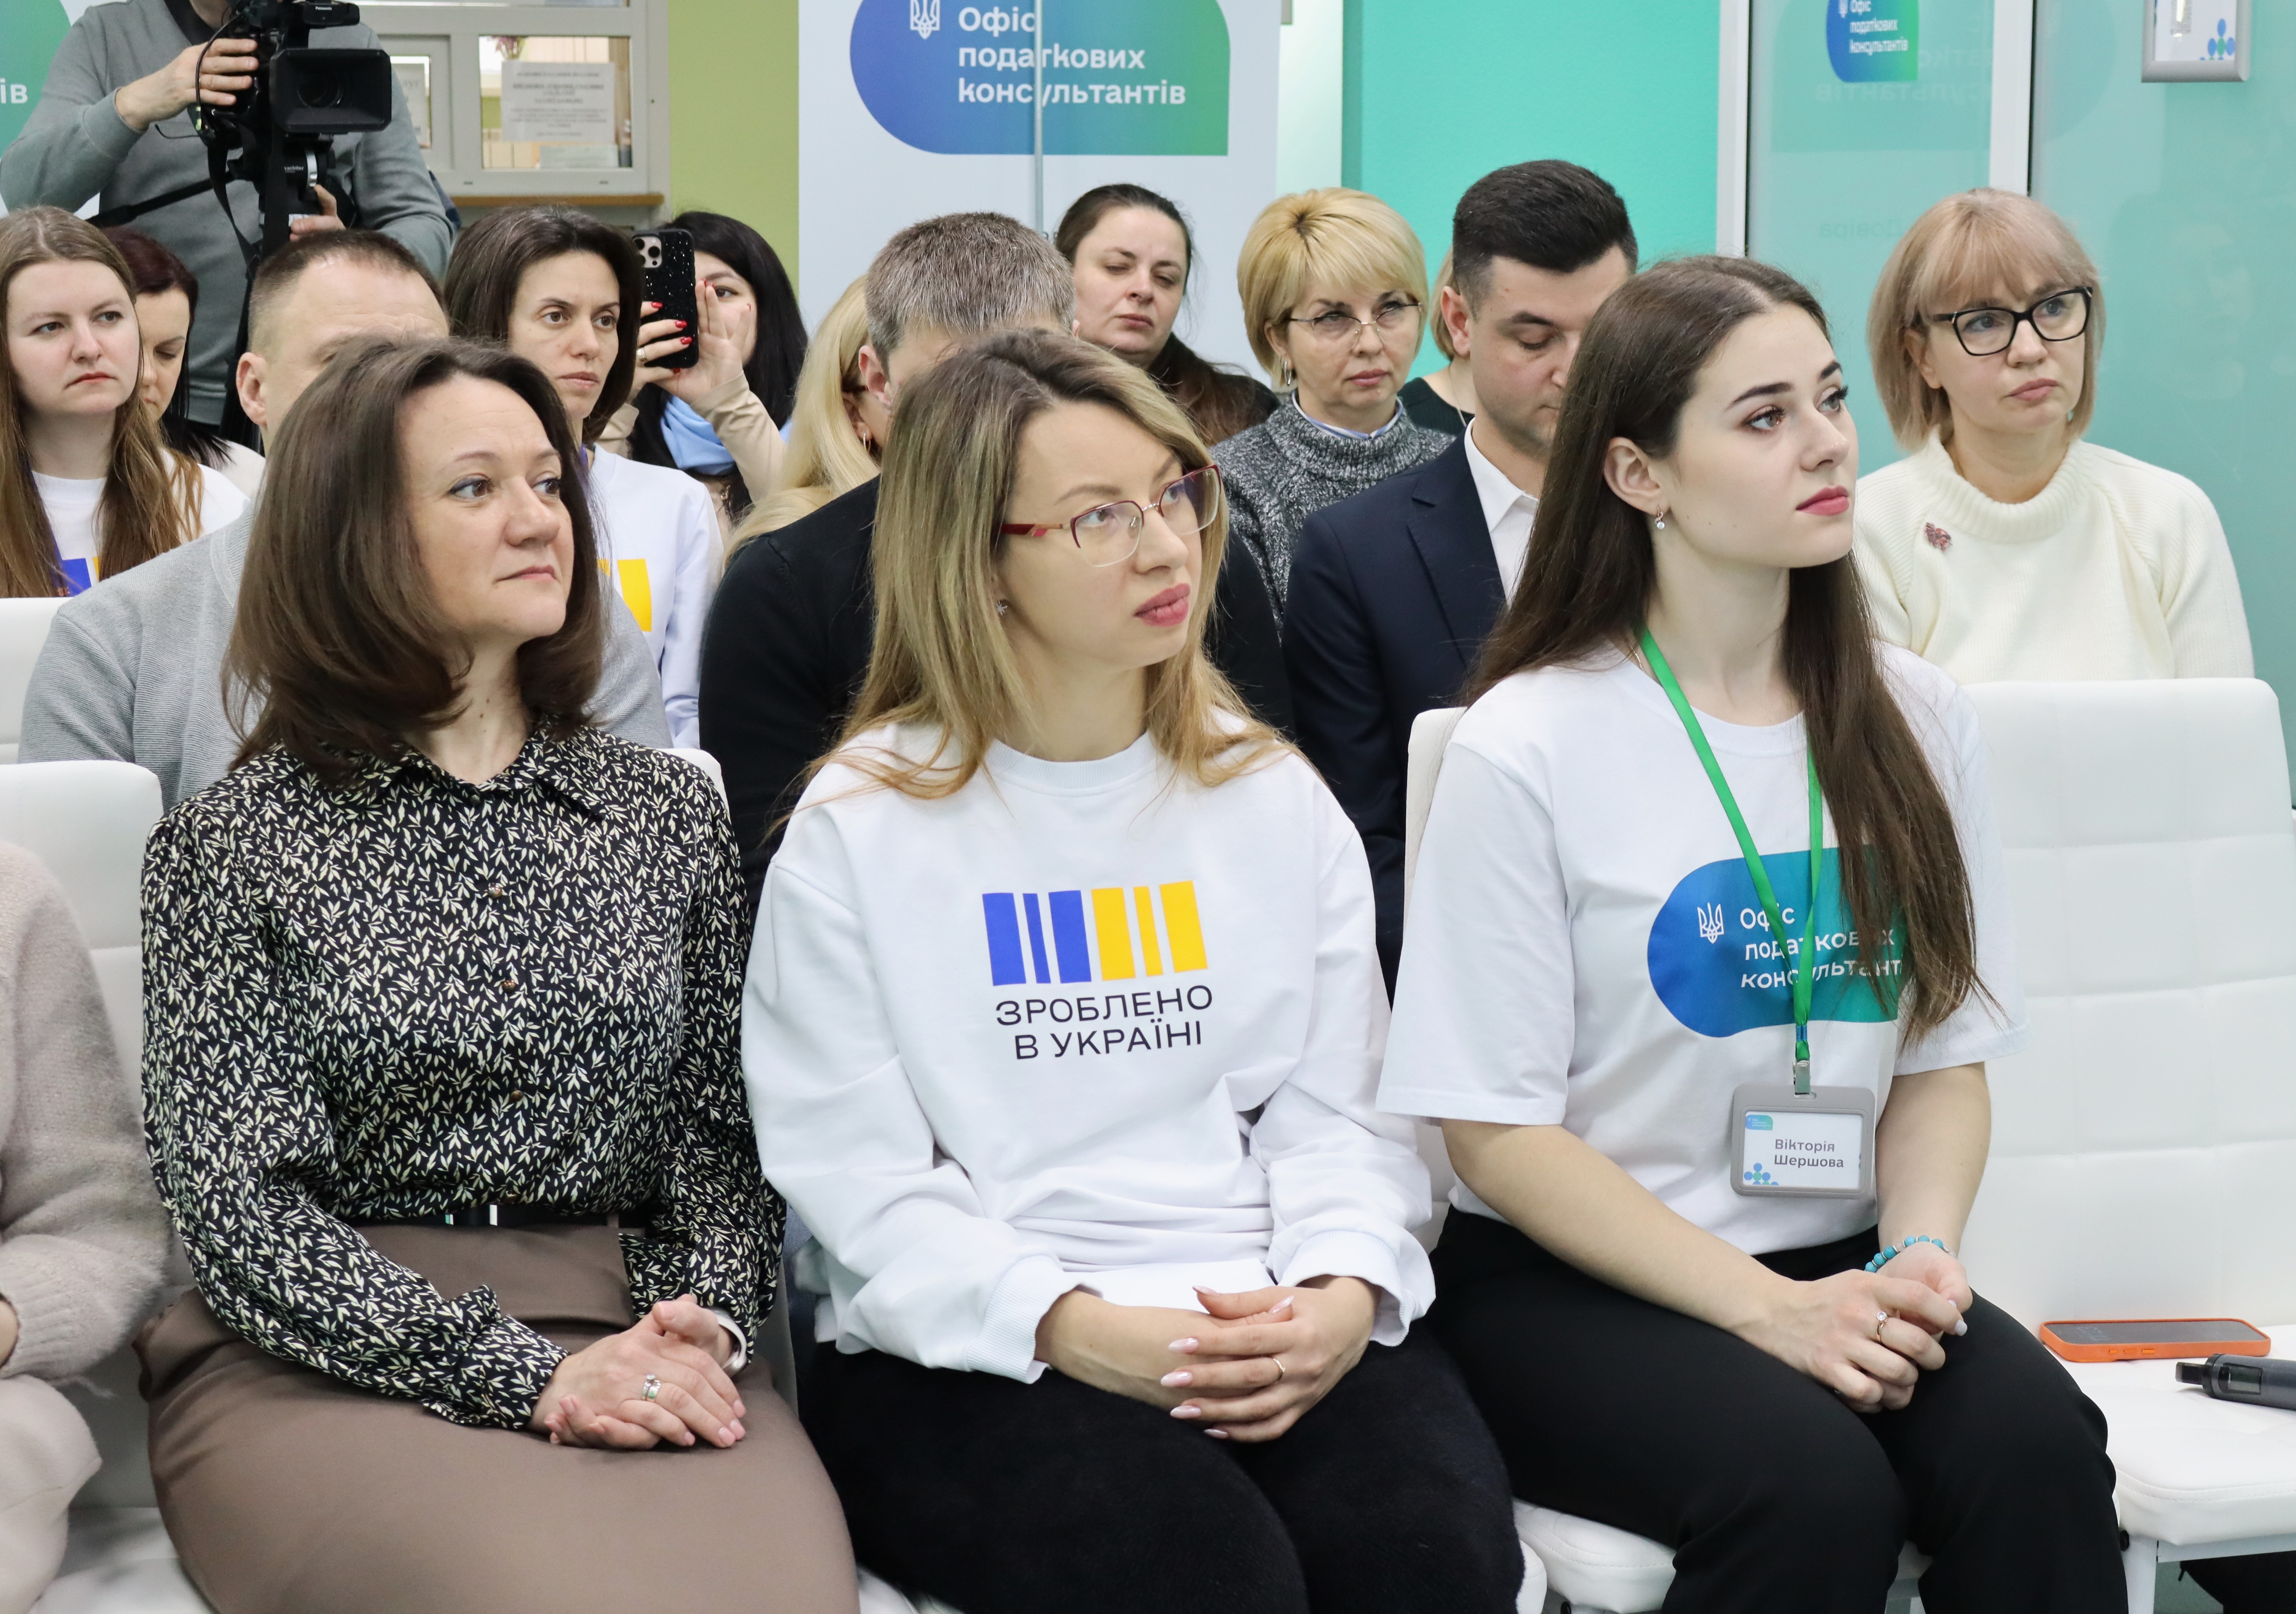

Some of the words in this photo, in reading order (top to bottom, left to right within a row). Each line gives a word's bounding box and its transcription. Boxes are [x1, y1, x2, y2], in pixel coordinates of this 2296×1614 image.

[959, 6, 1036, 38] Офіс
[1850, 17, 1898, 35] податкових
[1849, 36, 1908, 56] консультантів
[1740, 903, 1795, 932] Офс
[1745, 929, 1895, 960] подаковх
[996, 985, 1213, 1026] ЗРОБЛЕНО
[1014, 1034, 1039, 1060] В
[1050, 1018, 1201, 1058] УКРАЇНІ
[1774, 1154, 1844, 1168] Шершова
[1775, 1139, 1835, 1154] Вікторія
